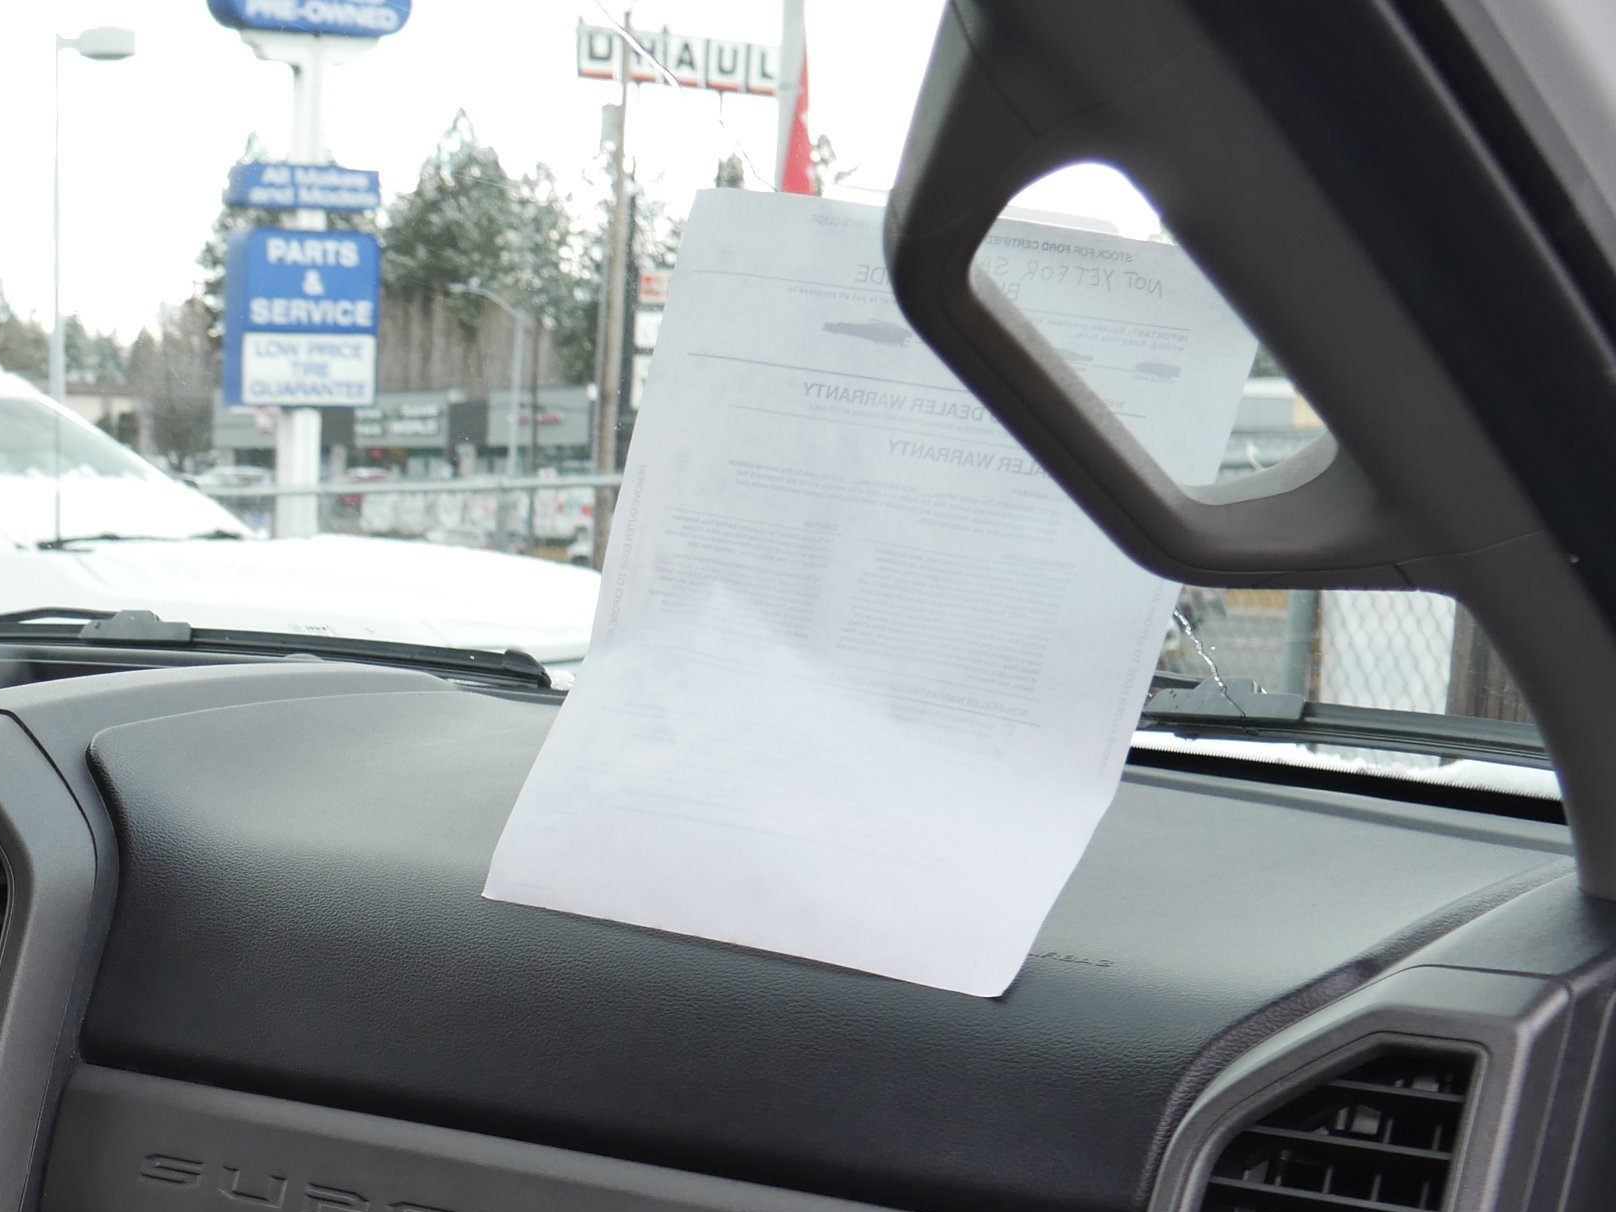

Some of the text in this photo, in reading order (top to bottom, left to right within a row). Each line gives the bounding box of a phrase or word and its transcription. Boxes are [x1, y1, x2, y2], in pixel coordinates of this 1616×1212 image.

[266, 237, 361, 267] PARTS
[302, 269, 324, 296] &
[250, 298, 373, 327] SERVICE
[255, 340, 364, 360] LOW PRICE
[250, 380, 367, 399] GUARANTEE
